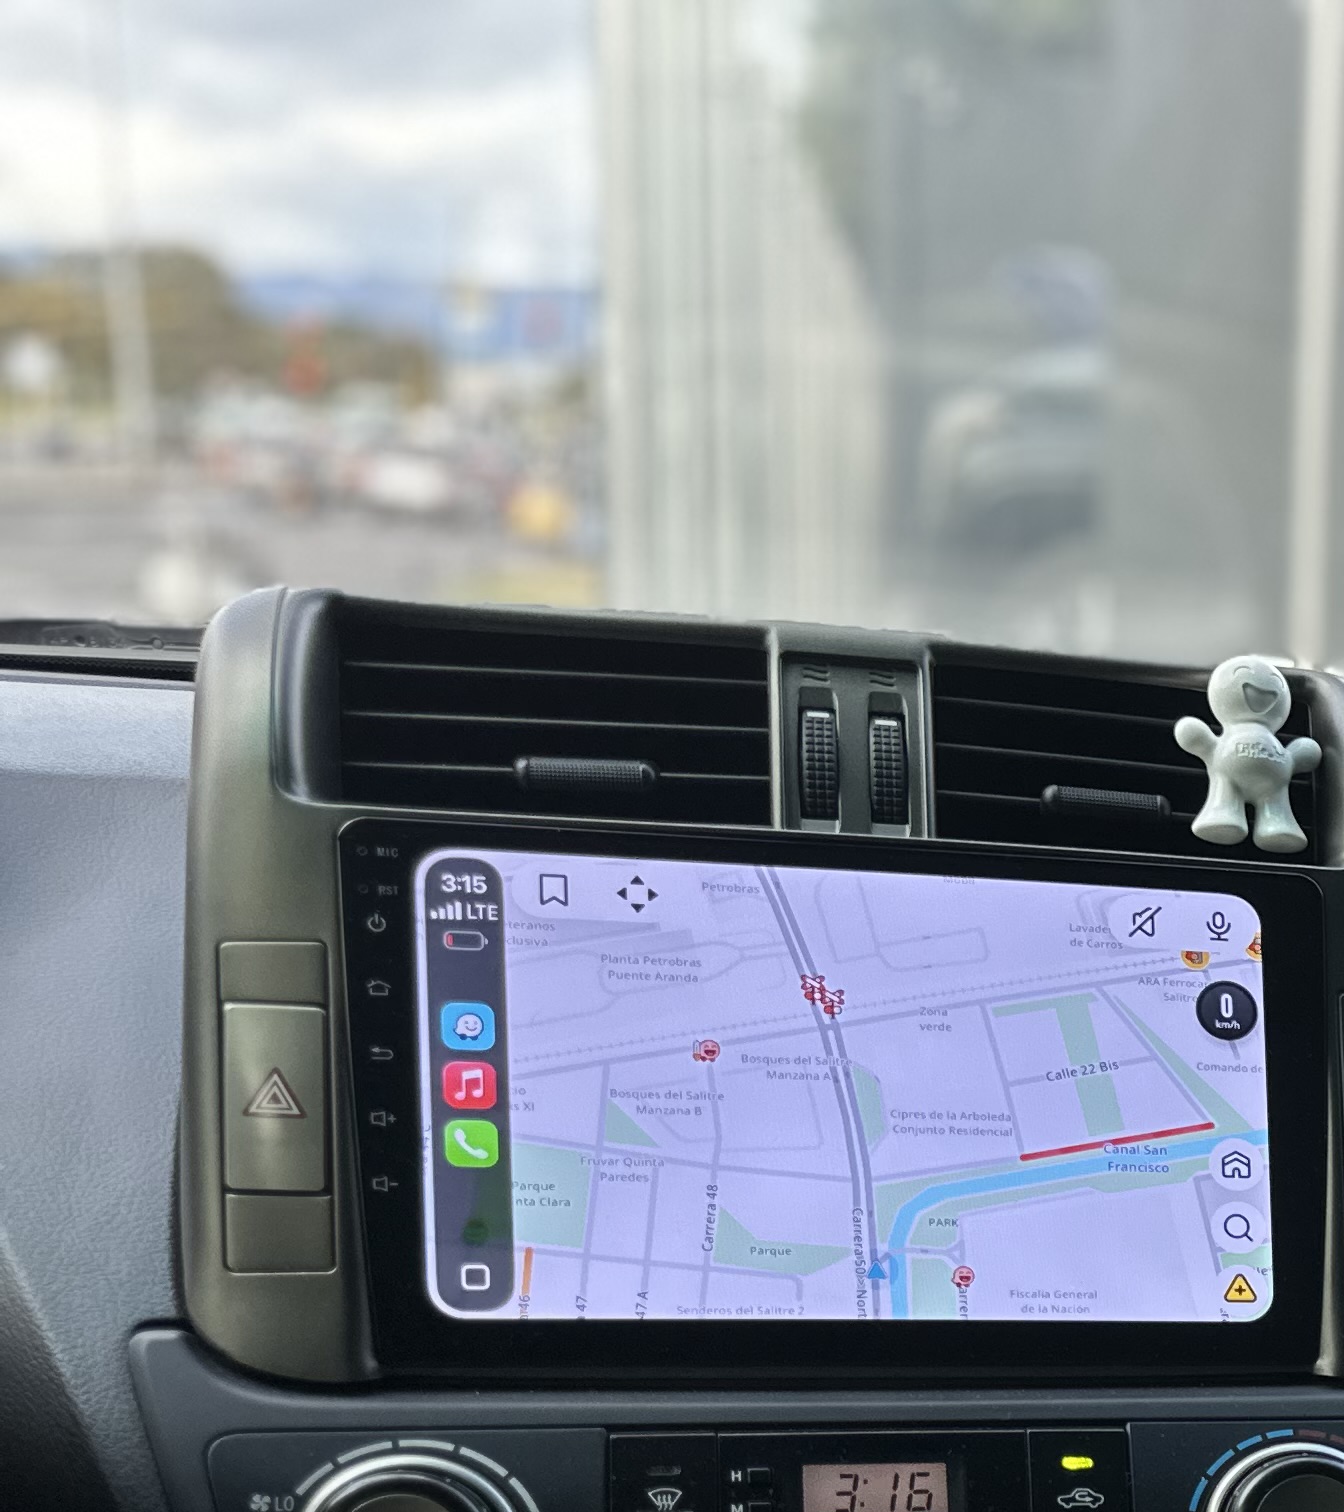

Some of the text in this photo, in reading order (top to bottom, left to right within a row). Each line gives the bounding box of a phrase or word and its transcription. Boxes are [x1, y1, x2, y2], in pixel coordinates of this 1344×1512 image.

[376, 847, 399, 858] MIC
[441, 872, 488, 894] 3:15
[702, 881, 760, 894] Petrobras
[377, 885, 399, 896] RST
[466, 904, 499, 921] LTE
[506, 921, 556, 932] teranos
[506, 936, 549, 947] clusiva
[1070, 938, 1123, 950] de Carros
[600, 953, 702, 968] Planta Petrobras
[608, 970, 699, 983] Puente Aranda
[1138, 976, 1160, 986] ARA
[919, 1006, 948, 1016] Zona
[1220, 993, 1233, 1018] 0
[919, 1022, 952, 1032] verde
[1215, 1019, 1241, 1030] km/h
[741, 1053, 853, 1067] Bosques del Salitre
[1046, 1060, 1119, 1082] Calle 22 Bis
[1196, 1062, 1248, 1073] Comando
[766, 1070, 832, 1081] Manzana A
[609, 1088, 725, 1101] Bosques del Salitre
[636, 1104, 703, 1116] Manzana B
[929, 1110, 943, 1120] de
[946, 1110, 957, 1120] la
[960, 1111, 1012, 1122] Arboleda
[892, 1124, 1013, 1137] Conjunto Residencial
[1103, 1144, 1167, 1156] Canal San
[580, 1156, 665, 1168] Fruvar Quinta
[1107, 1161, 1169, 1173] Francisco
[600, 1171, 650, 1182] Paredes
[512, 1181, 556, 1193] Parque
[539, 1197, 571, 1207] Clara
[702, 1184, 719, 1252] Carrera 48
[929, 1217, 959, 1227] PARK
[852, 1207, 864, 1256] Carrera
[750, 1246, 792, 1258] Parque
[637, 1291, 649, 1301] A
[1053, 1289, 1098, 1299] General
[958, 1287, 968, 1320] arrer
[1021, 1304, 1035, 1314] de
[1038, 1304, 1049, 1314] la
[676, 1305, 805, 1316] Senderos del Salitre 2
[731, 1471, 742, 1482] H
[274, 1495, 295, 1512] LO
